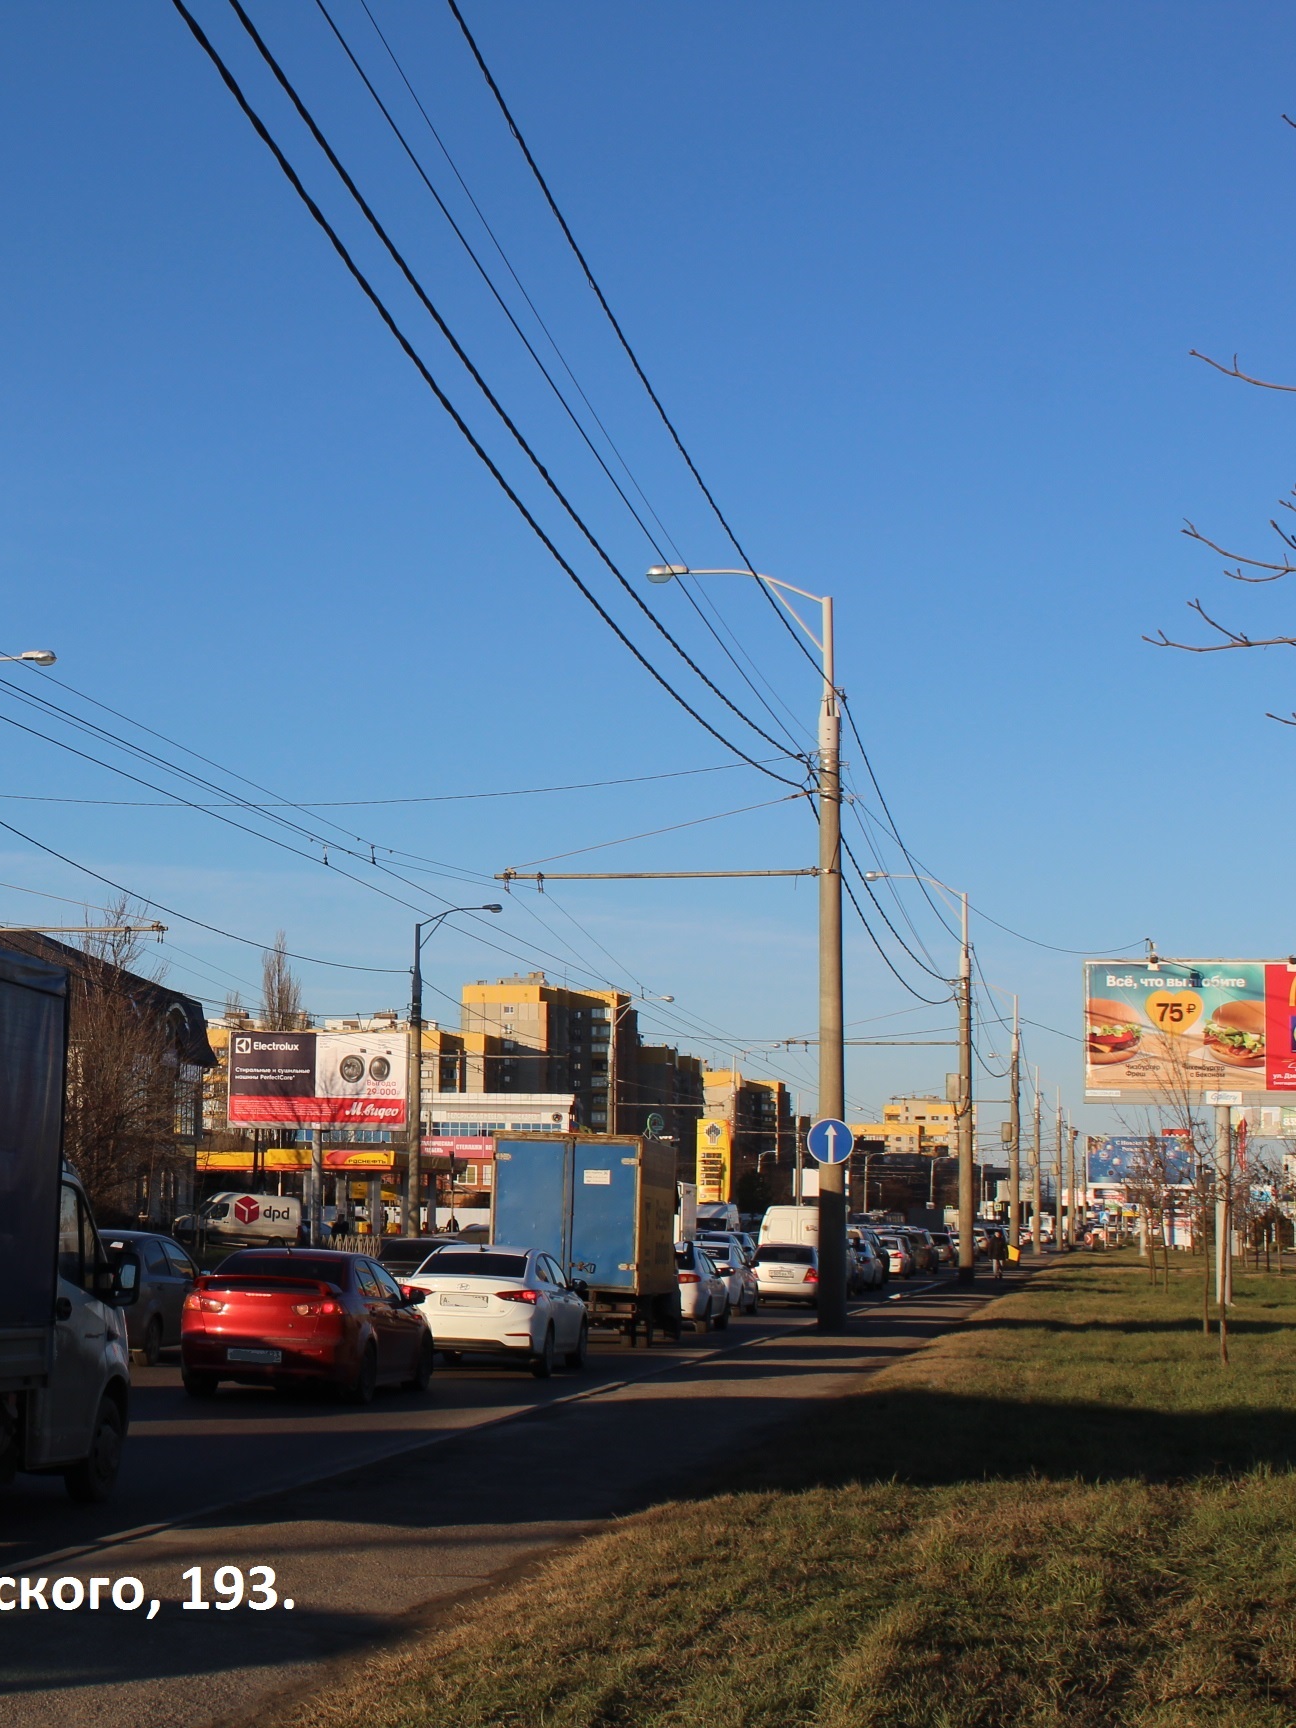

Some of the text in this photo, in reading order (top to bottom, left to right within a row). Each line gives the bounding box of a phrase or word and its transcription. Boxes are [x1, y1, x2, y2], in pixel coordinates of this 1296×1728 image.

[1106, 975, 1137, 989] Всё,
[1140, 977, 1163, 987] что
[1166, 977, 1186, 987] вы
[1156, 1002, 1184, 1023] 75
[253, 1041, 300, 1051] Electrolux
[235, 1066, 271, 1074] Стиральные
[1125, 1063, 1160, 1071] Чизбургер
[366, 1088, 377, 1096] 29
[345, 1102, 399, 1120] М.видео
[263, 1206, 290, 1222] dpd
